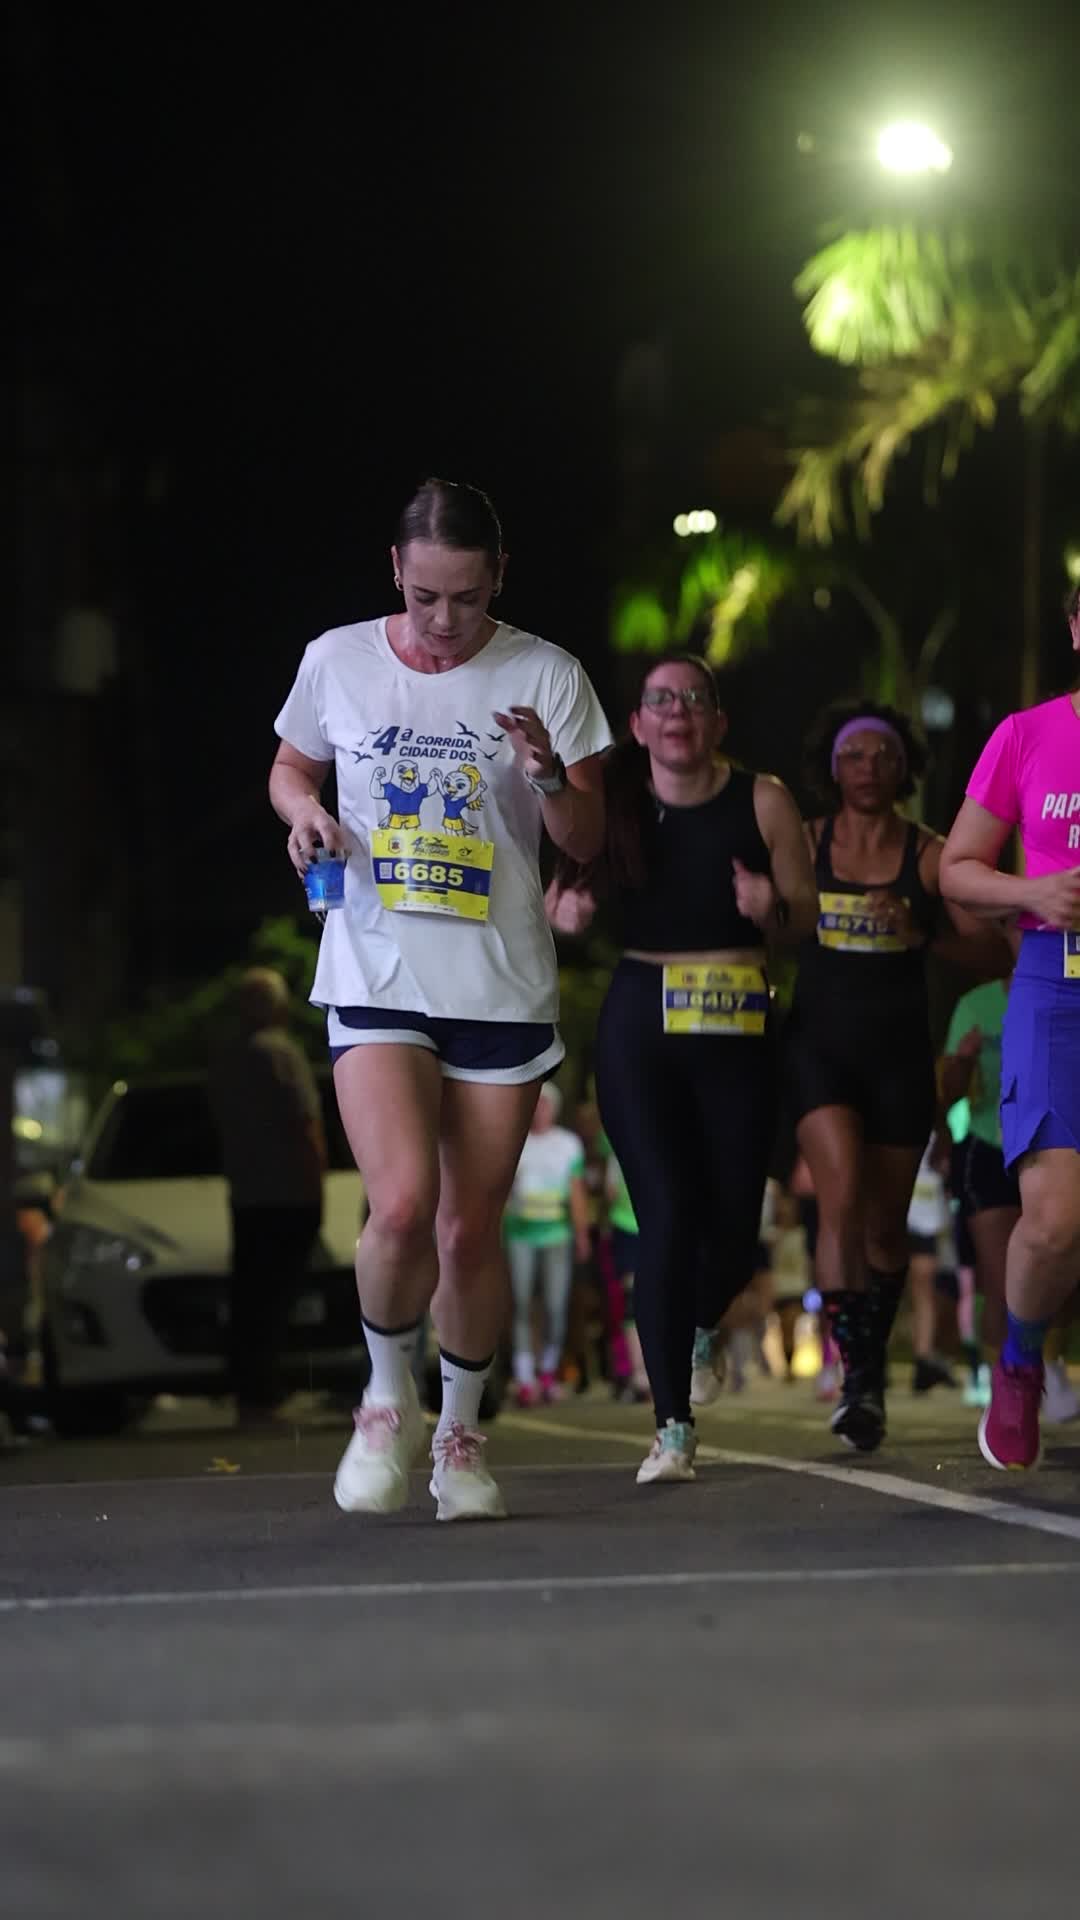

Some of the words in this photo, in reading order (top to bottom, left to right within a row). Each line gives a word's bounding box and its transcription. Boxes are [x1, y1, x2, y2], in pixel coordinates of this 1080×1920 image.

[416, 735, 473, 749] CORRIDA
[399, 746, 447, 759] CIDADE
[449, 750, 477, 762] DOS
[393, 862, 464, 886] 6685
